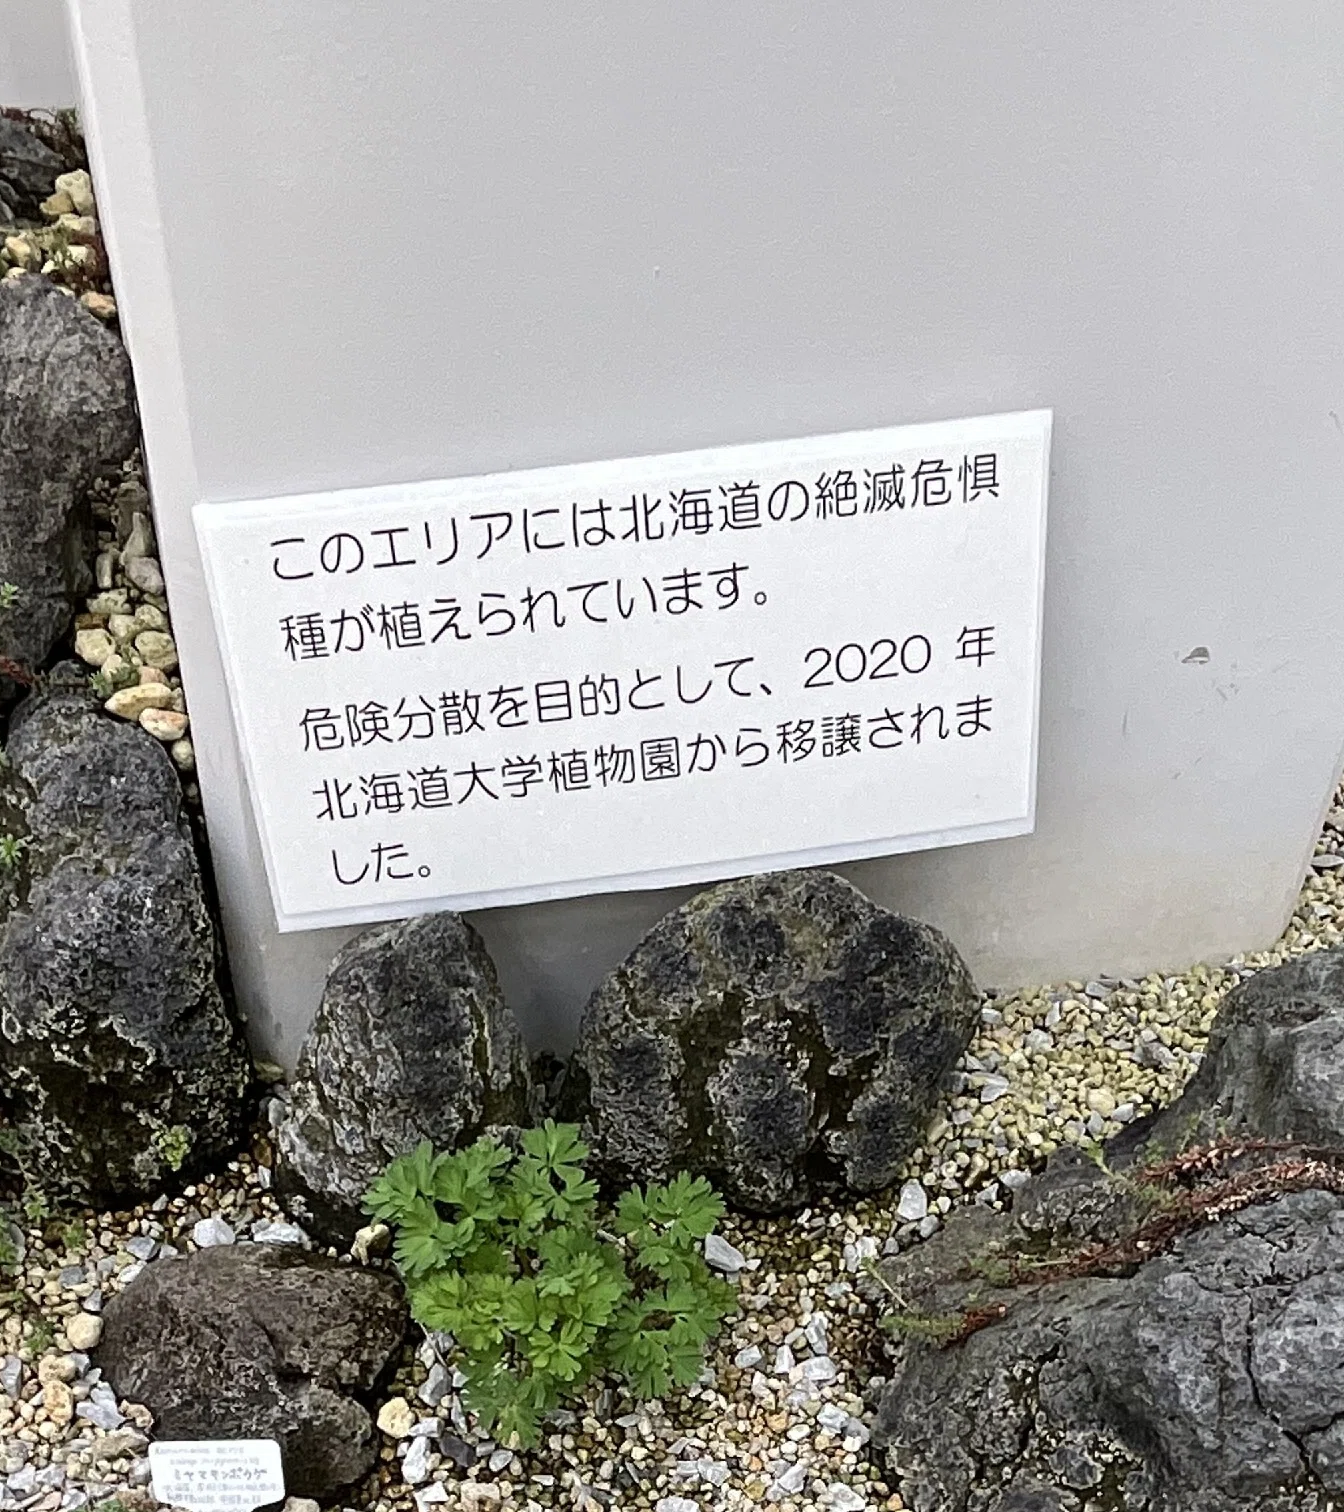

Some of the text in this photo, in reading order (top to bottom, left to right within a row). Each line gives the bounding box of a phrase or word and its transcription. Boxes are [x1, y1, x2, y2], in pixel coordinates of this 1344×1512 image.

[269, 452, 1001, 581] このエリアには北海道の絶滅危惧
[279, 560, 769, 663] 種が植えられています。
[312, 693, 994, 823] 北海道大学植物園から移譲されま
[330, 840, 432, 886] した。
